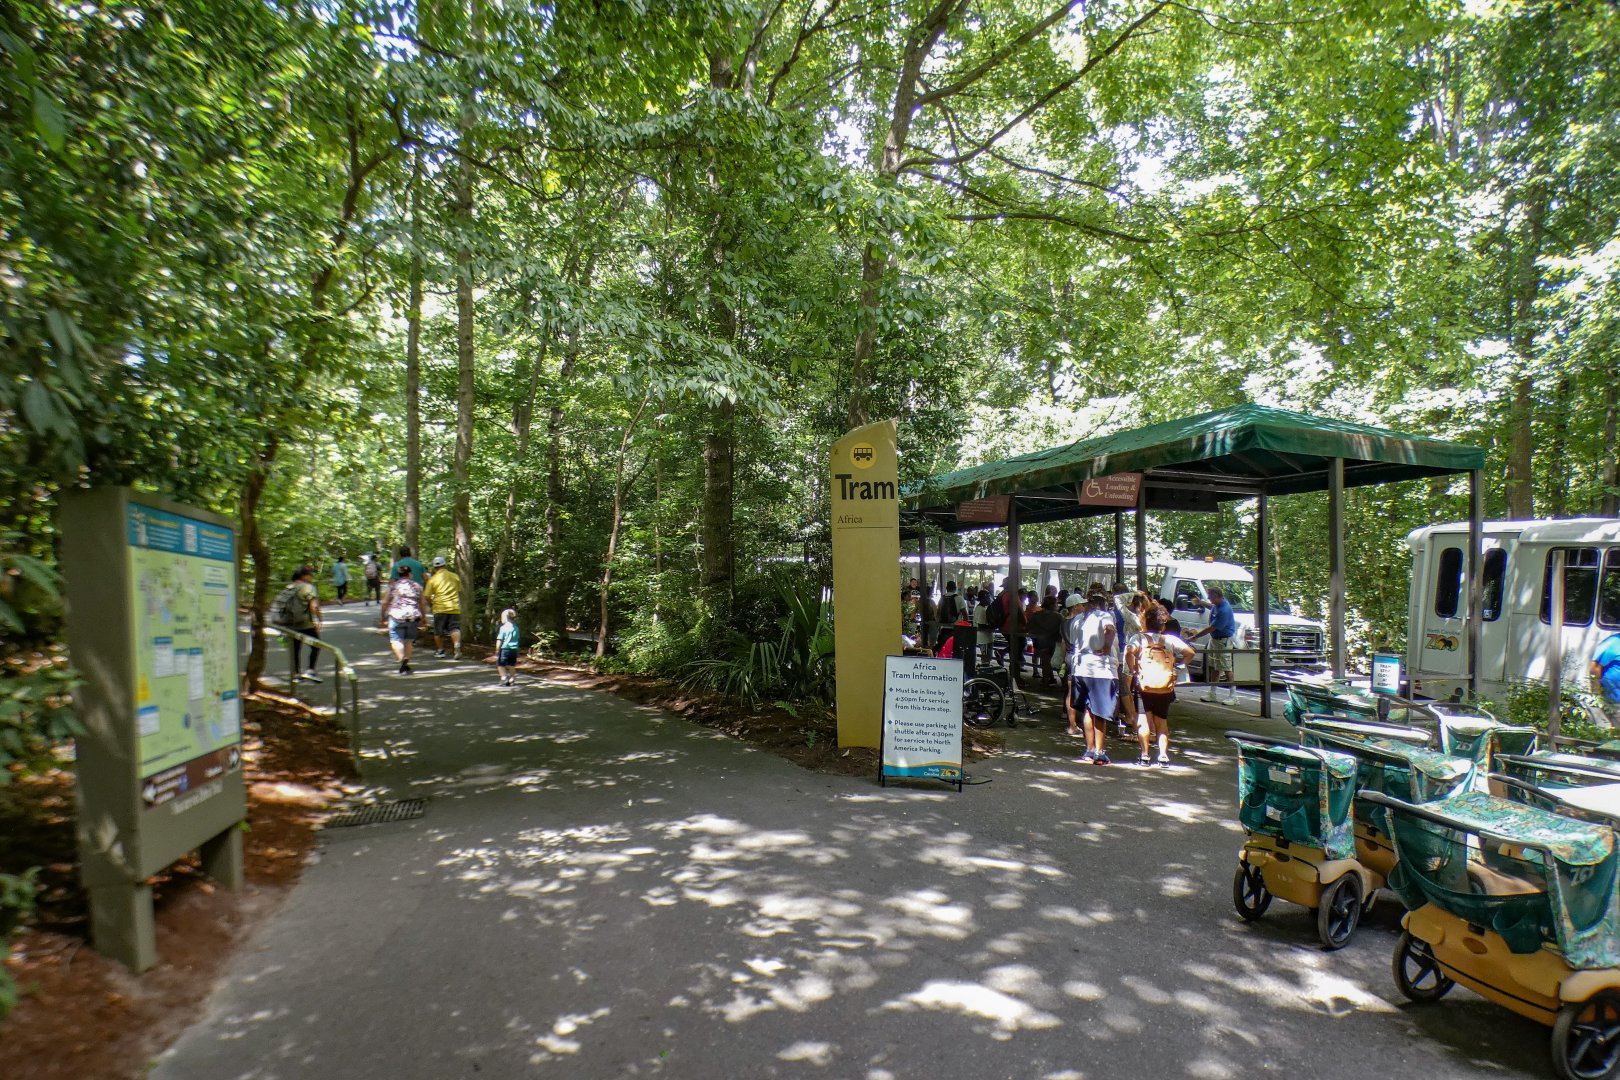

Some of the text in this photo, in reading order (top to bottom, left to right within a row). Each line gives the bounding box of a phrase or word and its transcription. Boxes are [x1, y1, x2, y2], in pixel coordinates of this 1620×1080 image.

[835, 474, 895, 500] Tram
[1105, 484, 1130, 492] Loading
[1104, 492, 1134, 501] Unloading
[837, 514, 863, 524] Africa
[913, 663, 937, 671] Africa
[892, 671, 958, 682] Tram Information
[938, 690, 945, 698] by
[926, 722, 947, 730] parking
[919, 746, 943, 754] Parking.
[940, 768, 960, 777] ZOO
